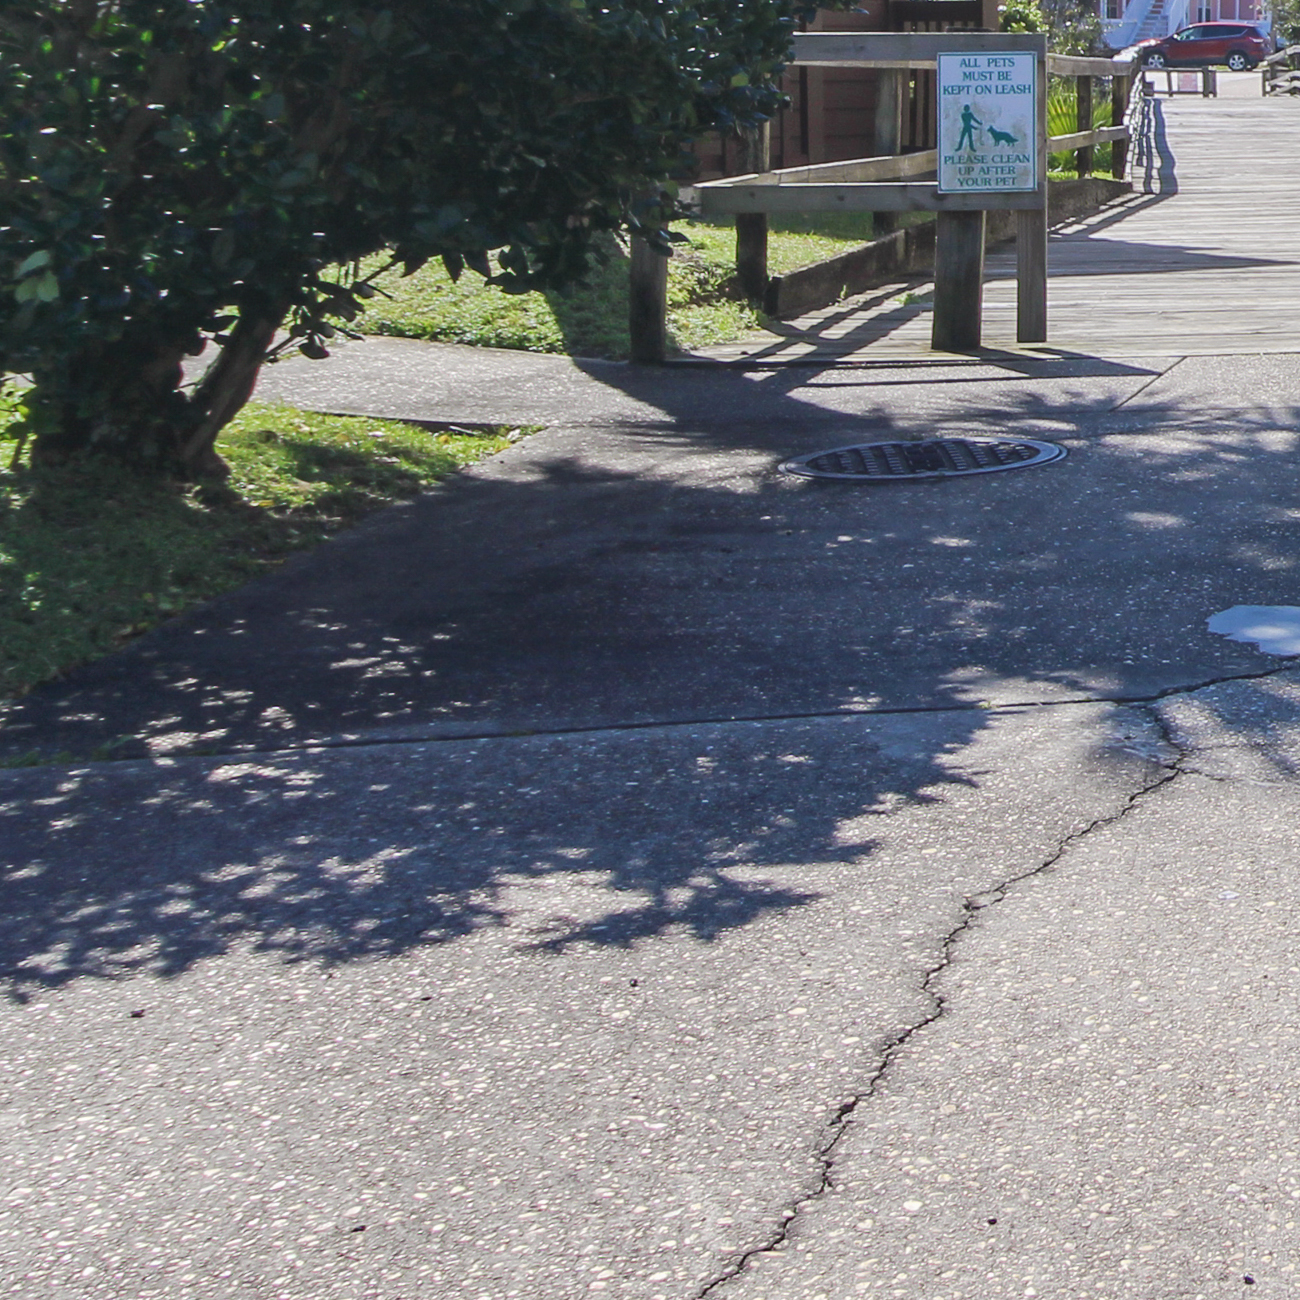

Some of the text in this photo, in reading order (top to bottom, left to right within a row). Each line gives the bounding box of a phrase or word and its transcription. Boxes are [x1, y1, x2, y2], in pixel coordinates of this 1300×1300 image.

[960, 58, 1015, 67] ALL PETS
[962, 71, 1012, 81] MUST BE
[943, 84, 1032, 95] KEPT ON LEASH
[944, 154, 1030, 164] PLEASE CLEAN
[958, 166, 1016, 176] UP AFTER
[957, 177, 1017, 187] YOUR PET
